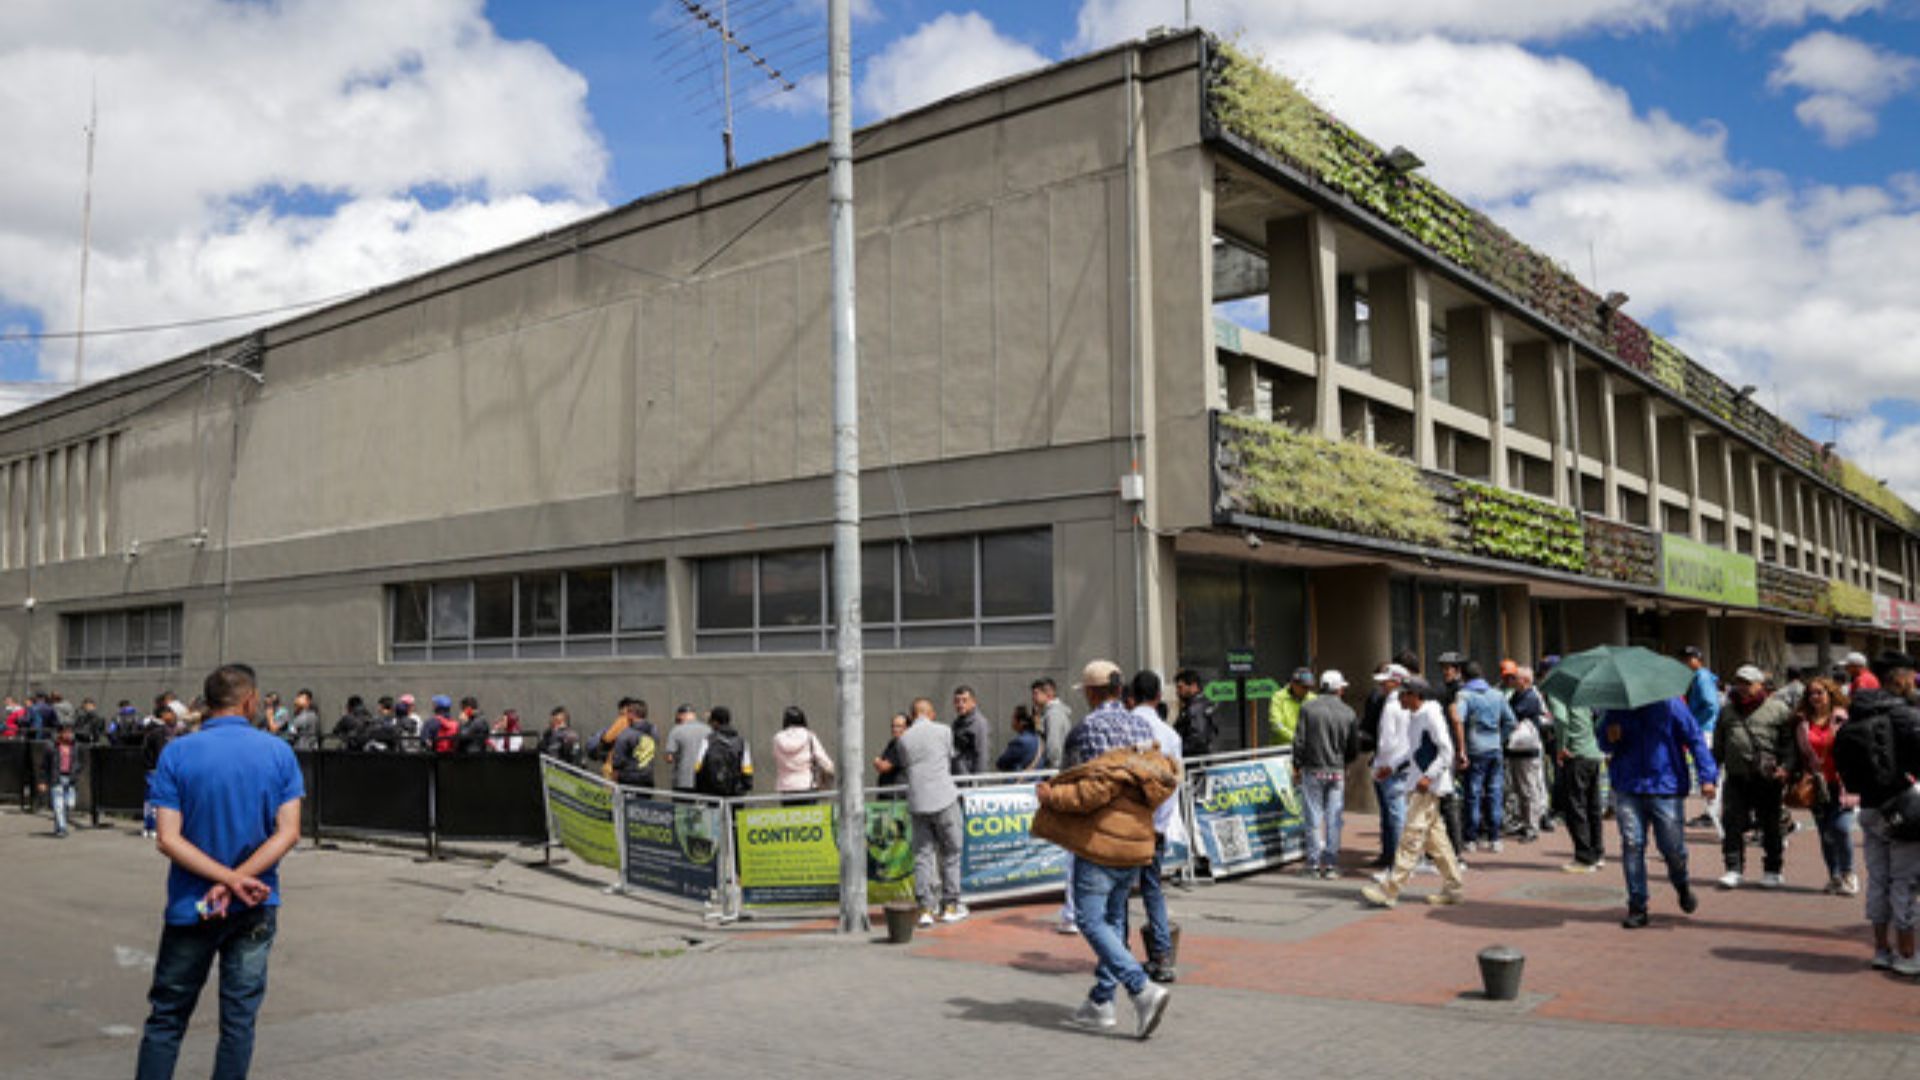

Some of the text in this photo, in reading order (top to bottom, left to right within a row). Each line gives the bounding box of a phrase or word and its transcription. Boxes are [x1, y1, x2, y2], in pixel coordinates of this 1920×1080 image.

[1203, 786, 1272, 812] CONTIGO
[748, 826, 823, 845] CONTIGO
[967, 811, 1034, 837] CONT
